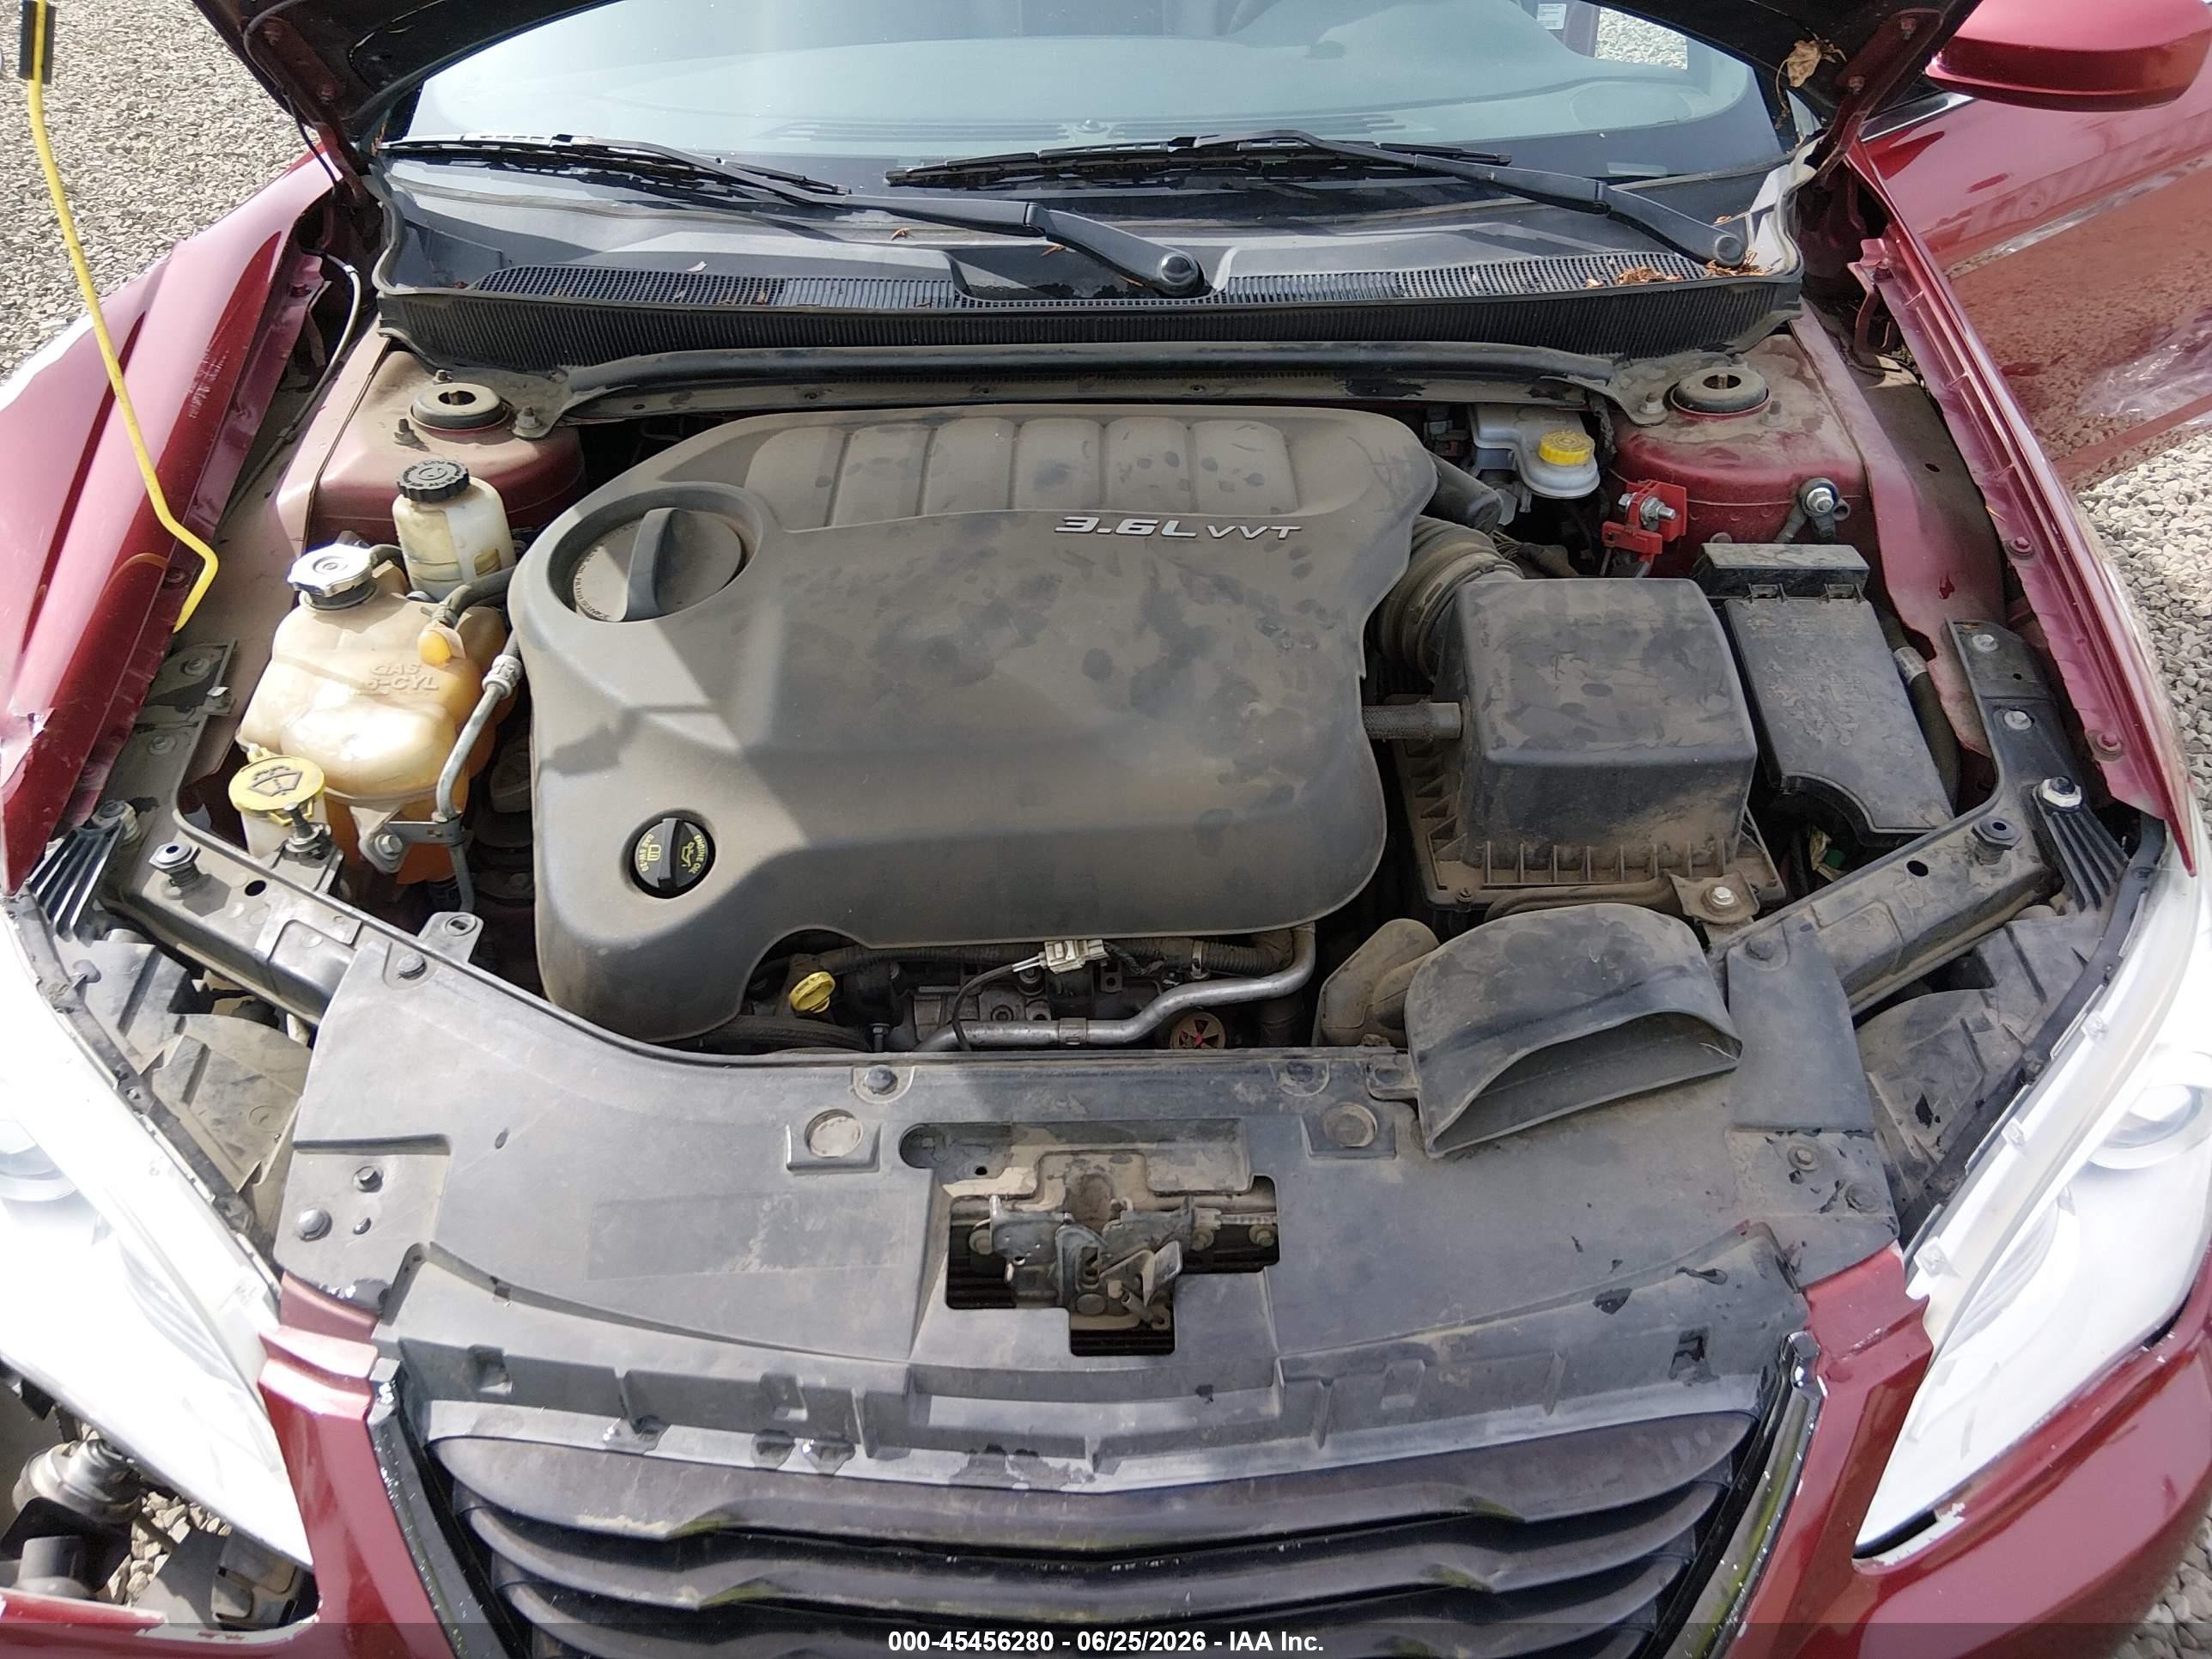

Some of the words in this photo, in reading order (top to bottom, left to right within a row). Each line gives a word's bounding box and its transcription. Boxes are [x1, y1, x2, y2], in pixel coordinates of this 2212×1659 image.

[1054, 516, 1197, 538] 3.6L
[1206, 525, 1302, 540] VVT
[371, 663, 421, 676] GAS
[641, 833, 654, 848] SAE
[694, 835, 704, 862] ENGINE
[638, 848, 649, 872] 5W-20
[688, 862, 701, 874] OIL
